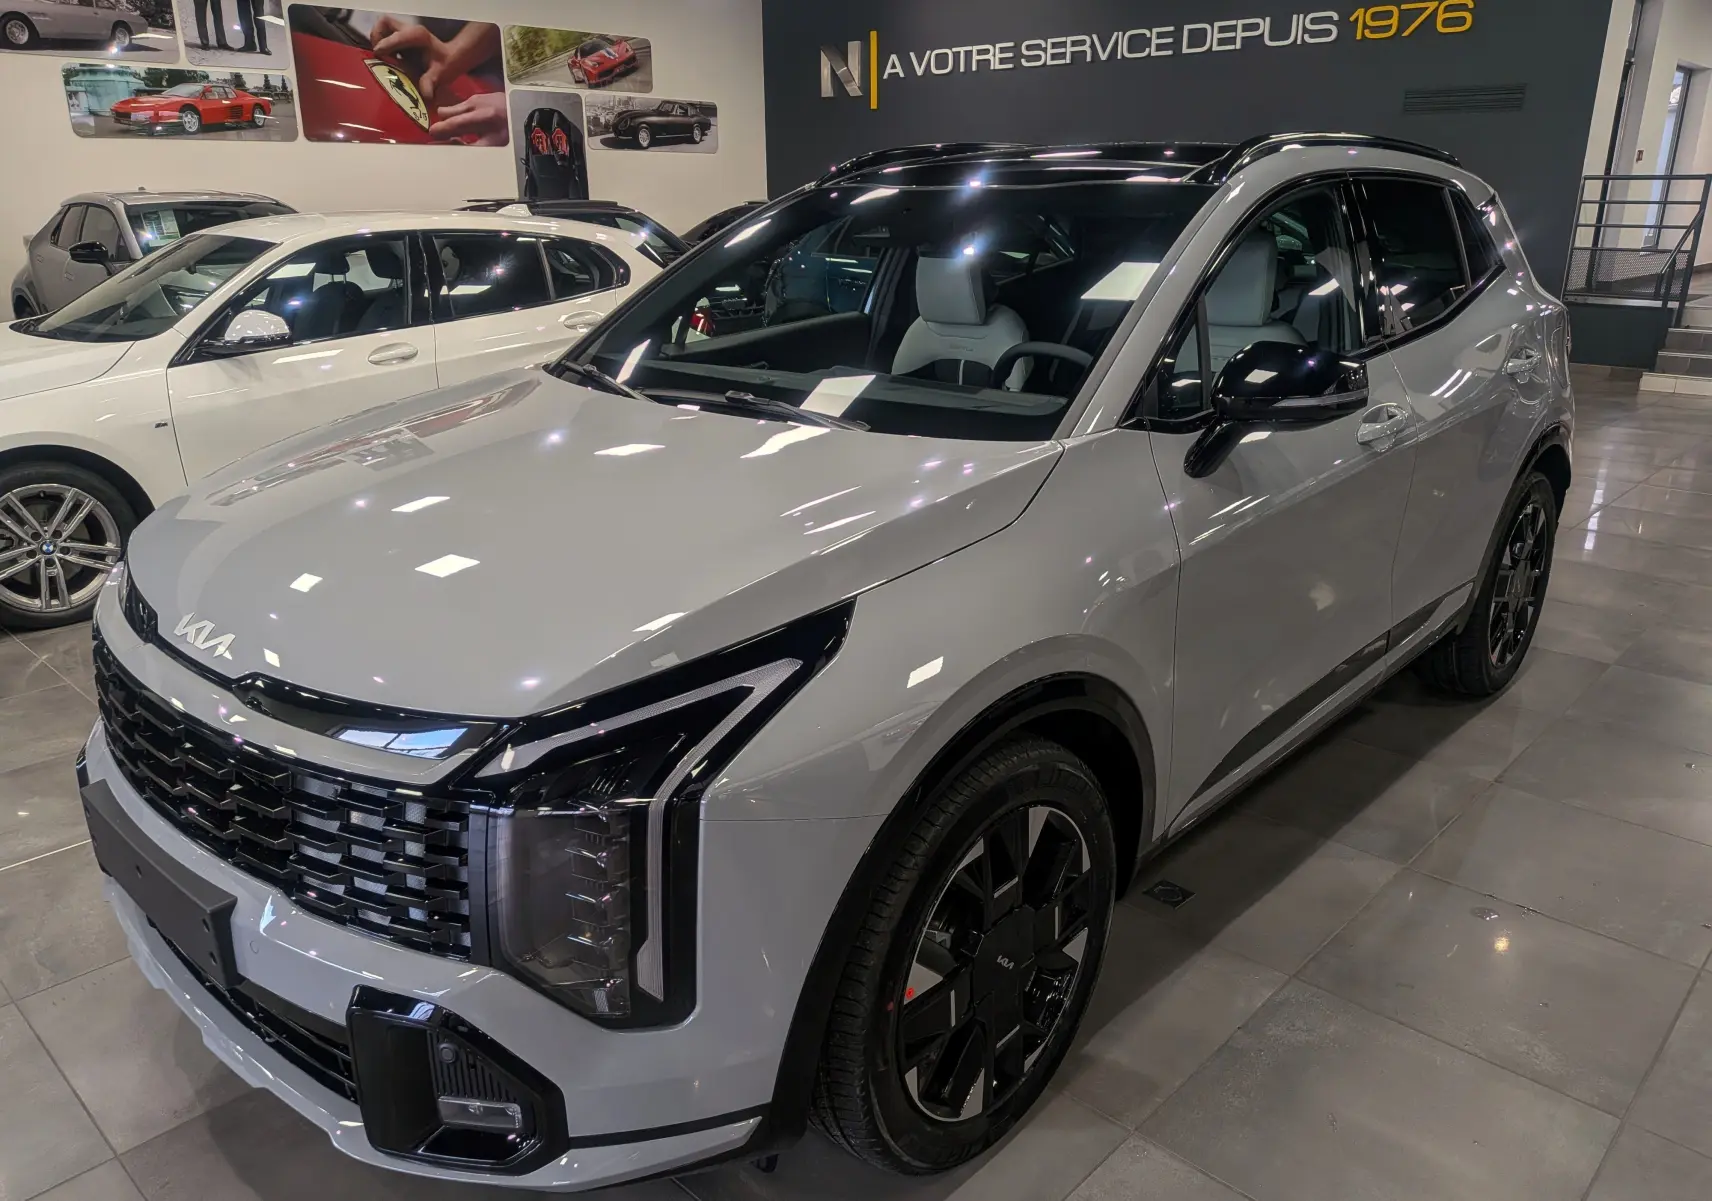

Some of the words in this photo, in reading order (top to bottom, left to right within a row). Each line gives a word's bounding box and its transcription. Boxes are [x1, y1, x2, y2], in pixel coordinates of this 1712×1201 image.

[883, 54, 905, 80] A
[909, 41, 1015, 77] VOTRE
[1020, 26, 1175, 67] SERVICE
[1182, 11, 1340, 54] DEPUIS
[1349, 0, 1475, 40] 1976
[820, 41, 863, 98] N
[173, 611, 236, 658] KIA
